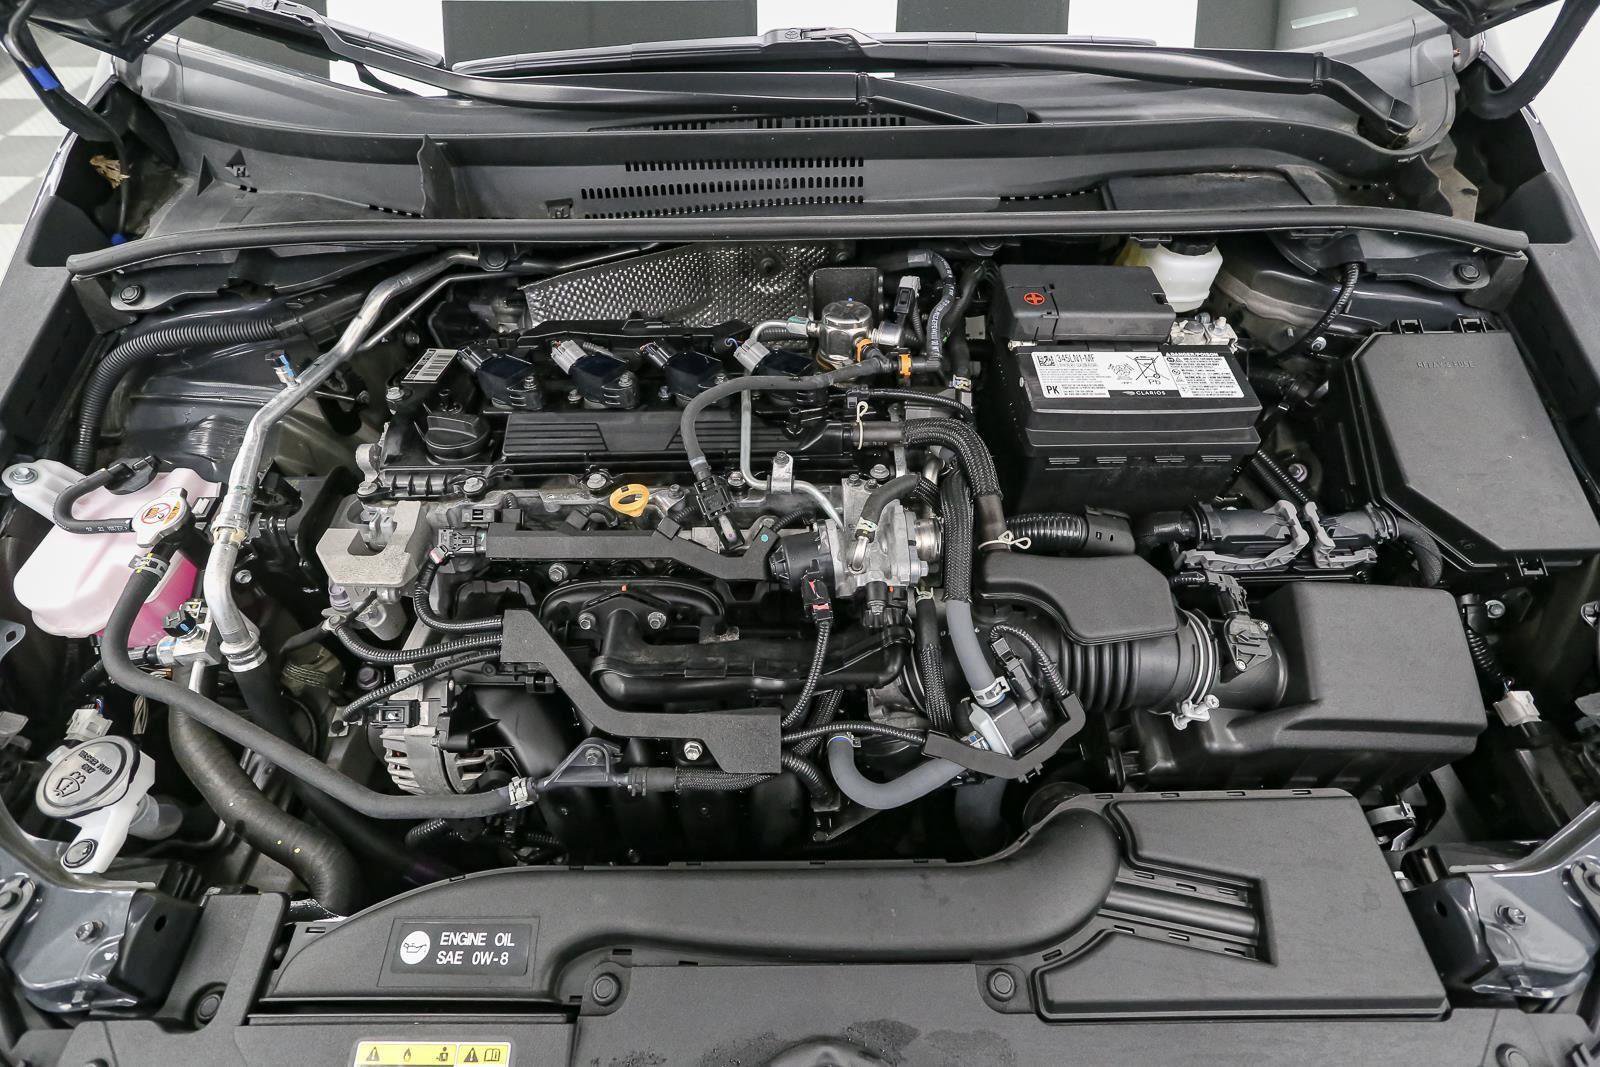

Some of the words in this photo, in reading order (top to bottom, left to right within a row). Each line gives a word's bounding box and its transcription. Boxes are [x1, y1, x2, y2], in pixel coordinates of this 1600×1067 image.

[1046, 385, 1060, 395] PK
[440, 932, 487, 946] ENGINE
[494, 932, 515, 946] OIL
[436, 950, 464, 965] SAE
[471, 951, 509, 966] 0W-8
